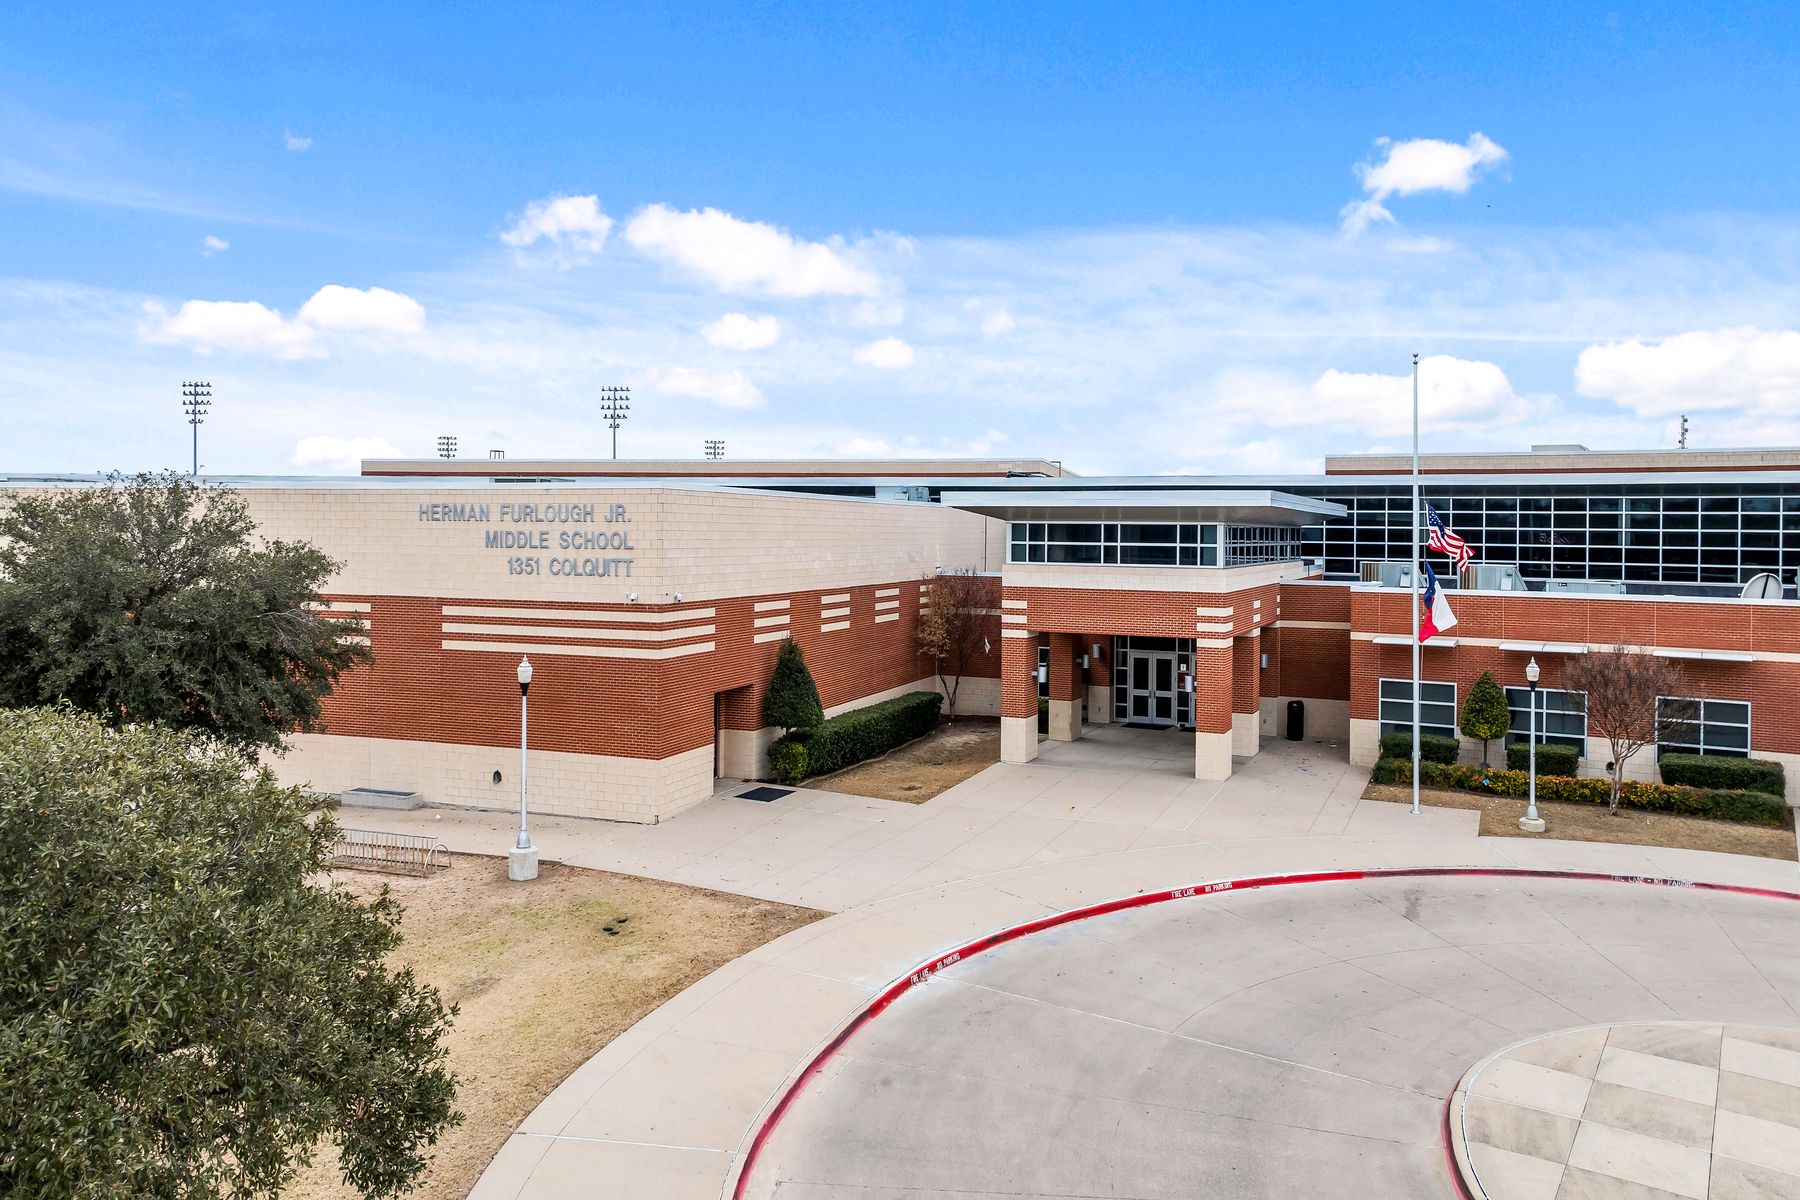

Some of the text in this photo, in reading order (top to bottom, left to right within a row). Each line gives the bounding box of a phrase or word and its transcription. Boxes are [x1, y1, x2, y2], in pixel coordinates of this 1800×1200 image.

[419, 503, 632, 523] HERMAN FURLOUGH JR.
[485, 530, 634, 550] MIDDLE SCHOOL
[507, 557, 634, 577] 1351 COLQUITT
